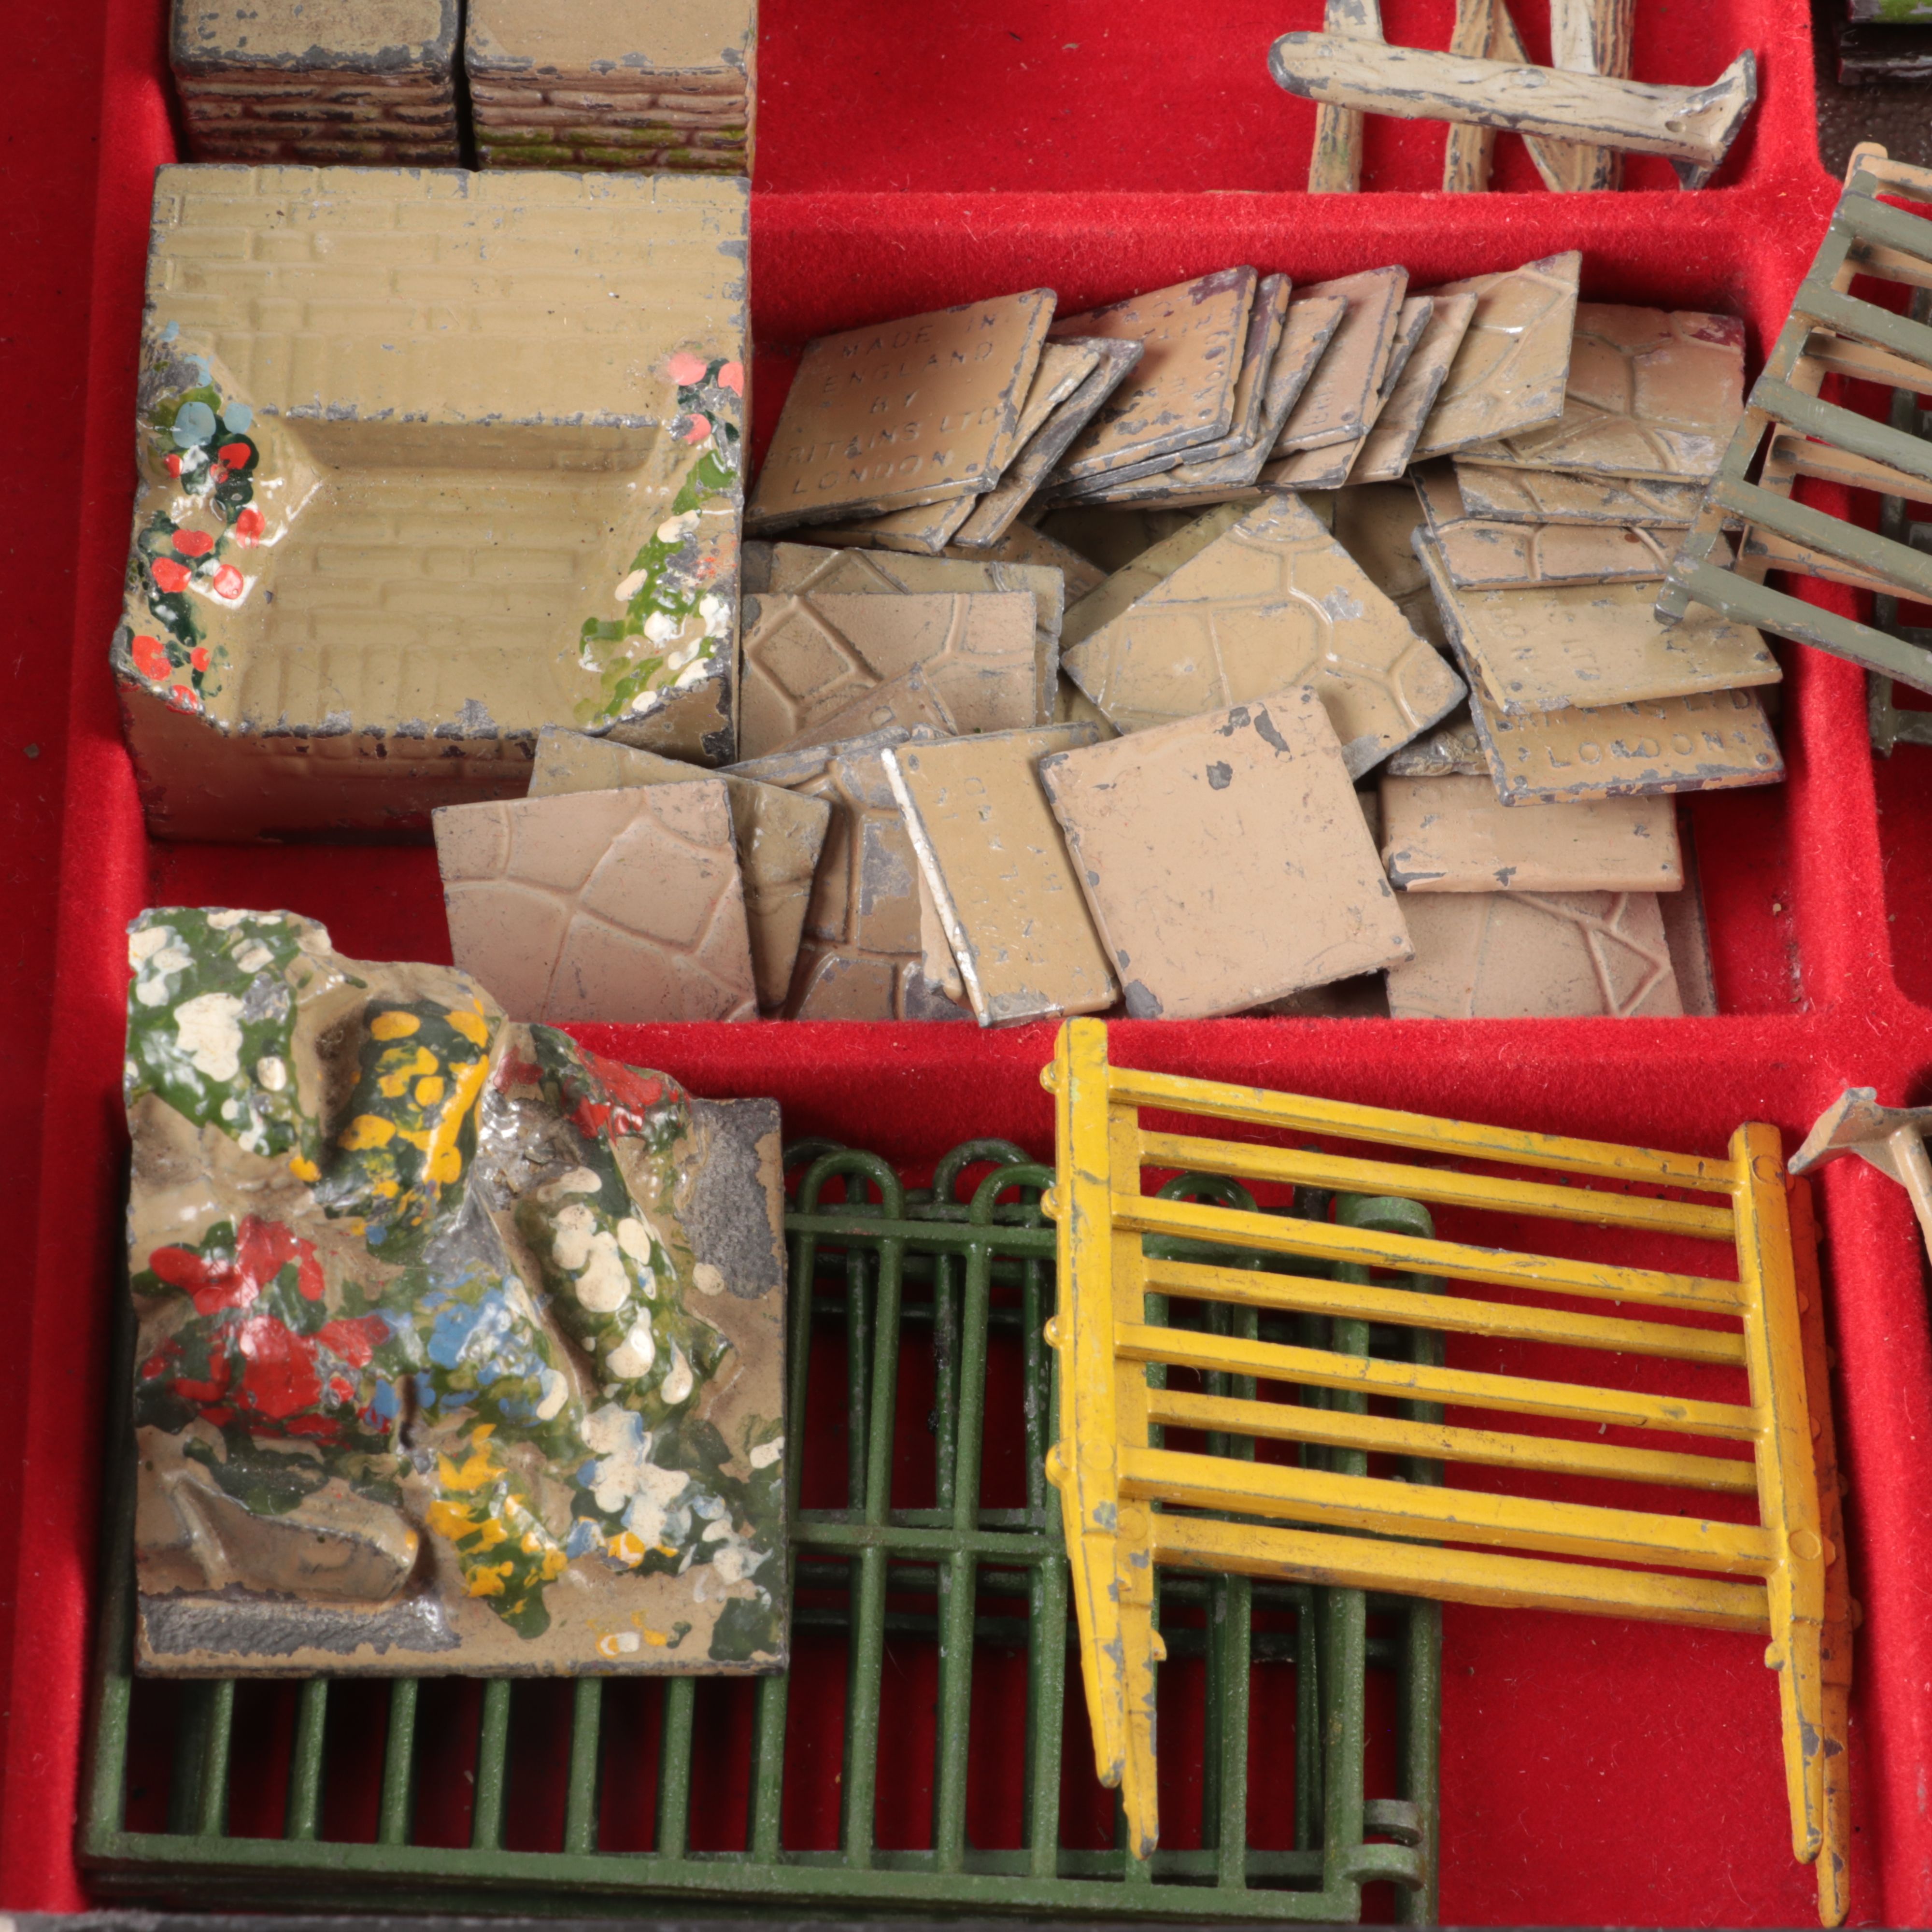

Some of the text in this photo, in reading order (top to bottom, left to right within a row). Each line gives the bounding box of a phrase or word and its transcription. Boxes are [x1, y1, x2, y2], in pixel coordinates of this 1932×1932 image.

[842, 315, 995, 357] MADE IN
[824, 341, 993, 393] ENGLAND
[869, 389, 919, 414] BY
[940, 407, 1002, 431] LTD
[793, 450, 955, 494] LONDON
[1546, 731, 1723, 767] LONDON
